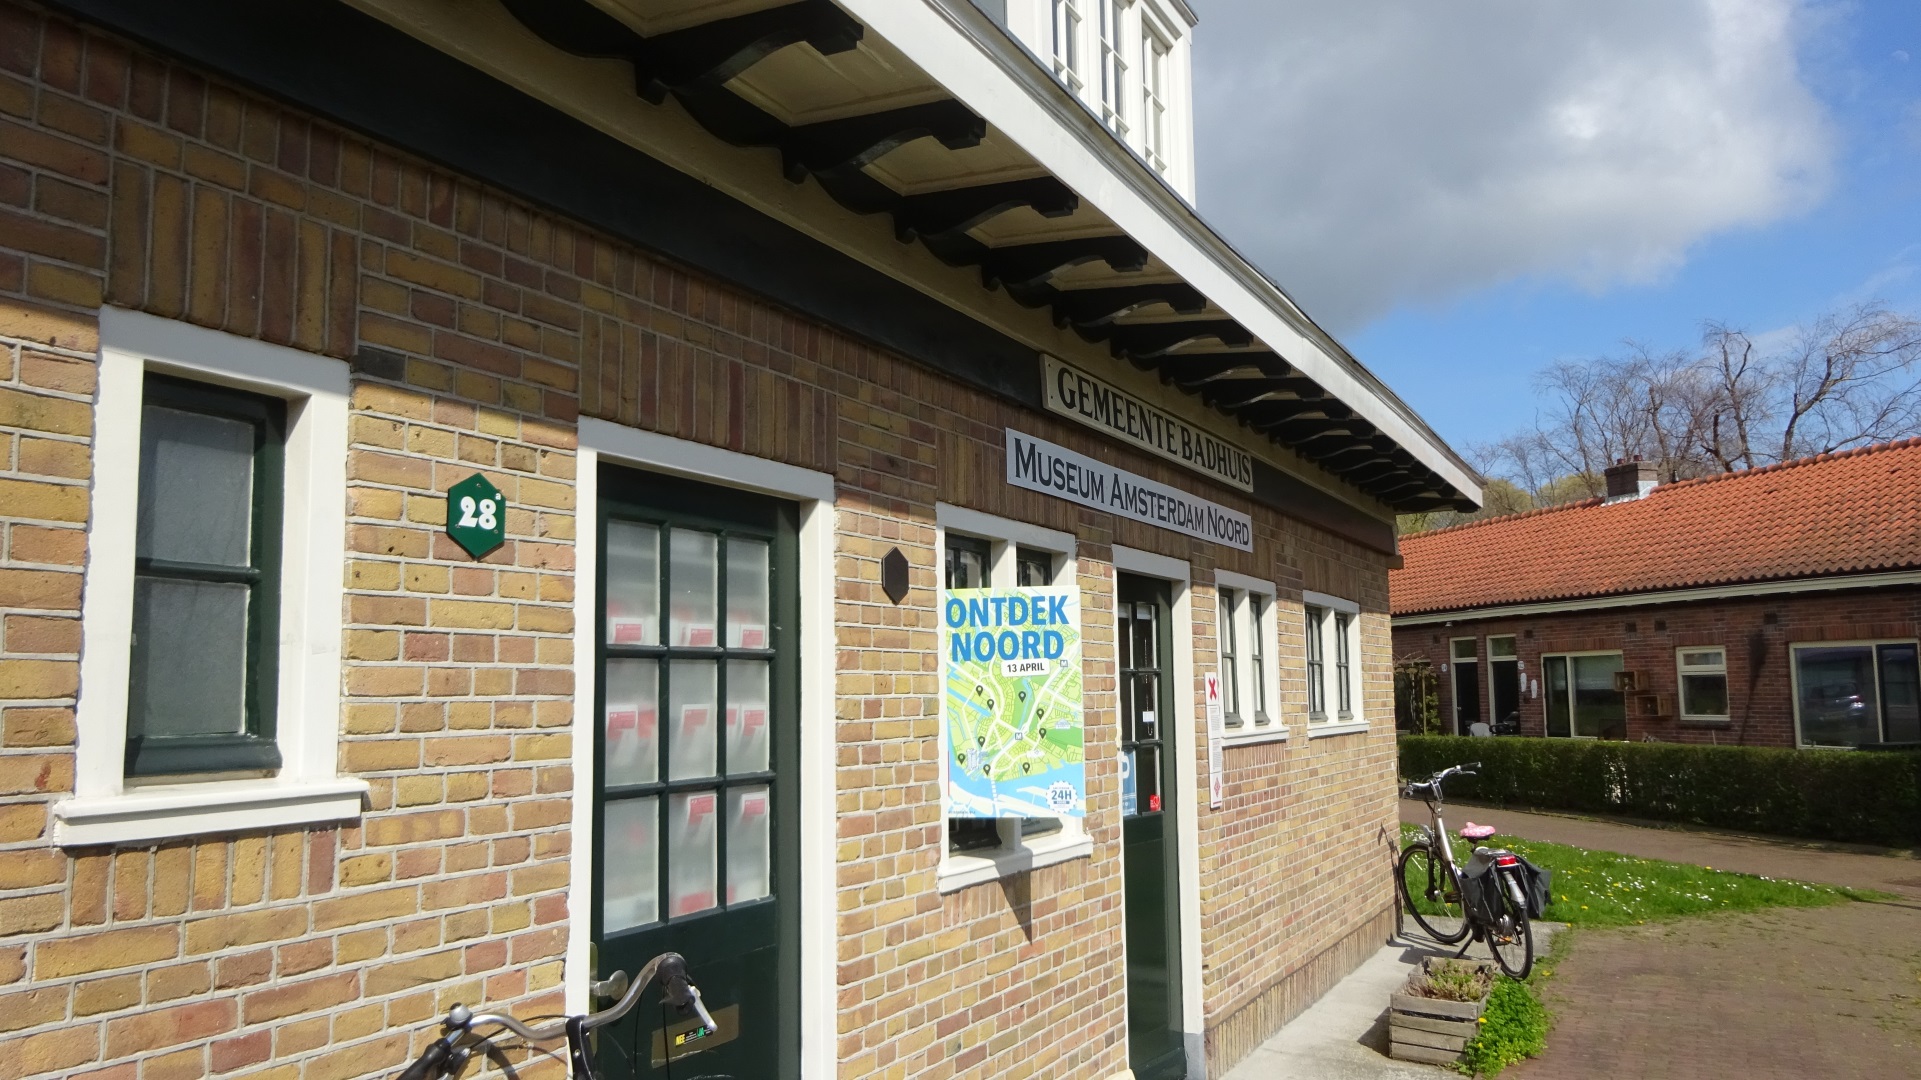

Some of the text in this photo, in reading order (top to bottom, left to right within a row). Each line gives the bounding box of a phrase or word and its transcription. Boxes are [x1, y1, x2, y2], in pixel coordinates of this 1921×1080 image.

[1014, 437, 1250, 546] MUSEUM AMSTERDAM NOORD
[945, 595, 1070, 628] ONTDEK
[951, 630, 1064, 662] NOORD
[1006, 662, 1045, 673] 13 APRIL
[1051, 789, 1072, 800] 24H
